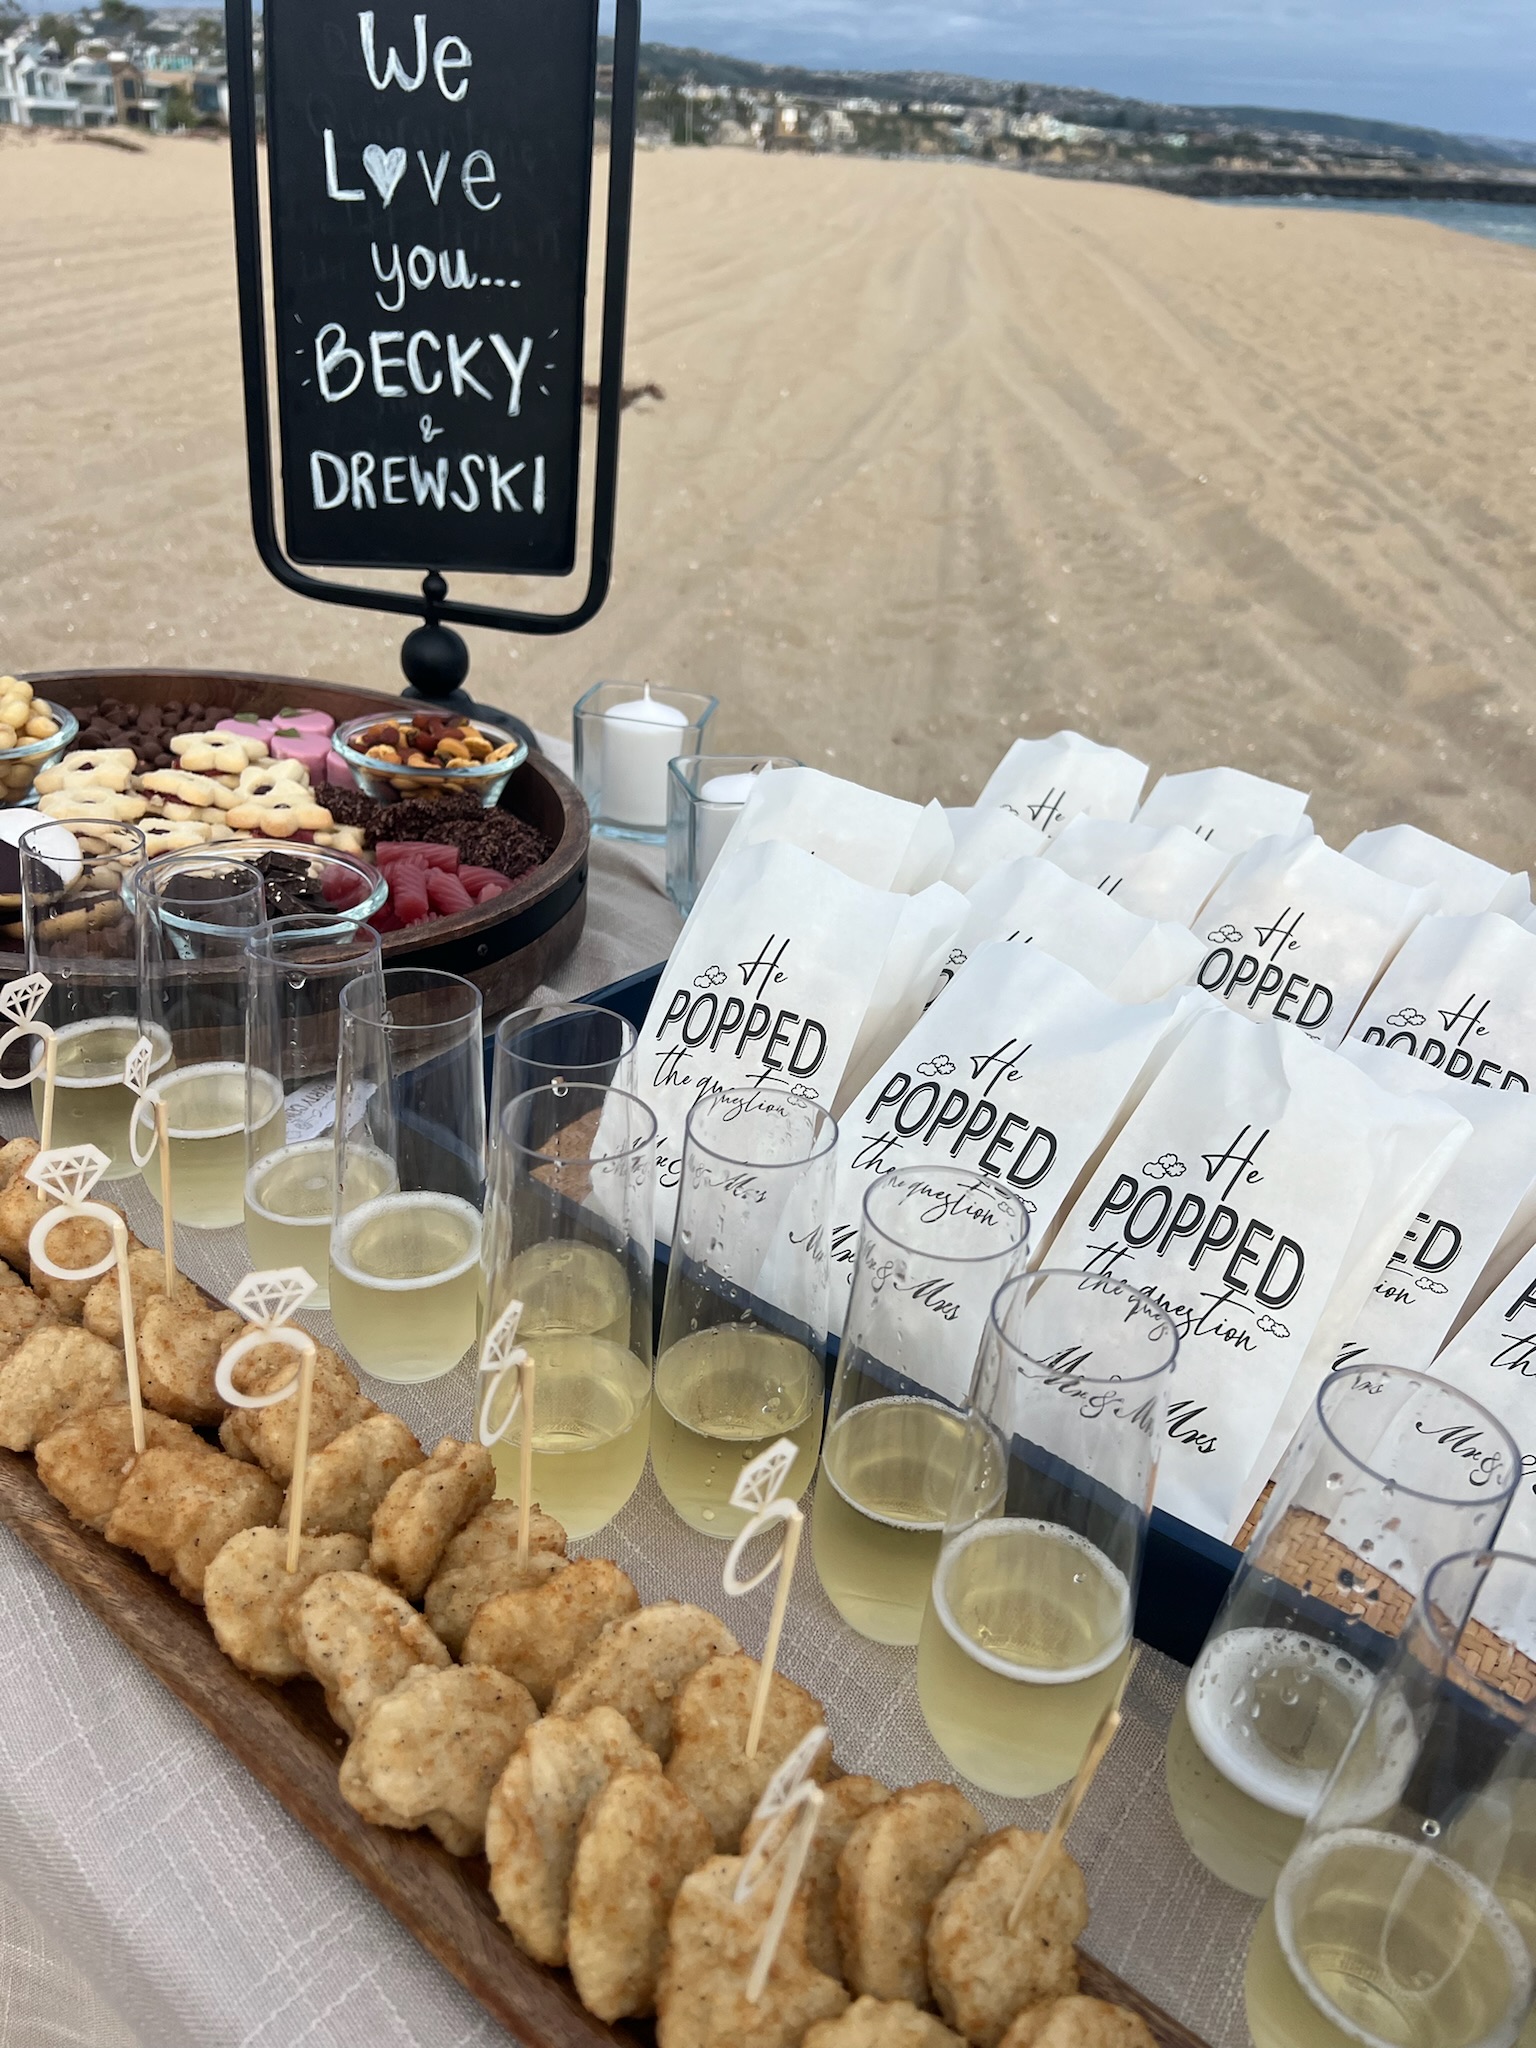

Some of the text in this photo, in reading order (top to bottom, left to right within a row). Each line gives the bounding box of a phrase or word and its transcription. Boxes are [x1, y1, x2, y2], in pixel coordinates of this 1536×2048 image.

[358, 11, 472, 101] We
[371, 242, 521, 312] you...
[315, 323, 534, 416] BECKY
[419, 414, 444, 443] &
[310, 450, 546, 514] DREWSKI
[1027, 787, 1066, 832] He
[1254, 906, 1305, 962] He
[738, 934, 790, 1001] He
[1197, 947, 1334, 1030] OPPED
[656, 989, 828, 1079] POPPED
[1437, 993, 1491, 1047] He
[653, 1044, 694, 1087] the
[970, 1038, 1033, 1097] He
[851, 1131, 904, 1174] the
[865, 1072, 1058, 1189] POPPED
[1201, 1124, 1270, 1202] He
[898, 1173, 999, 1227] question
[1077, 1241, 1136, 1296] the
[1089, 1173, 1306, 1310] POPPED
[893, 1278, 961, 1321] Mrs
[1127, 1285, 1258, 1352] question
[1490, 1333, 1536, 1377] th
[1415, 1421, 1484, 1462] Mr
